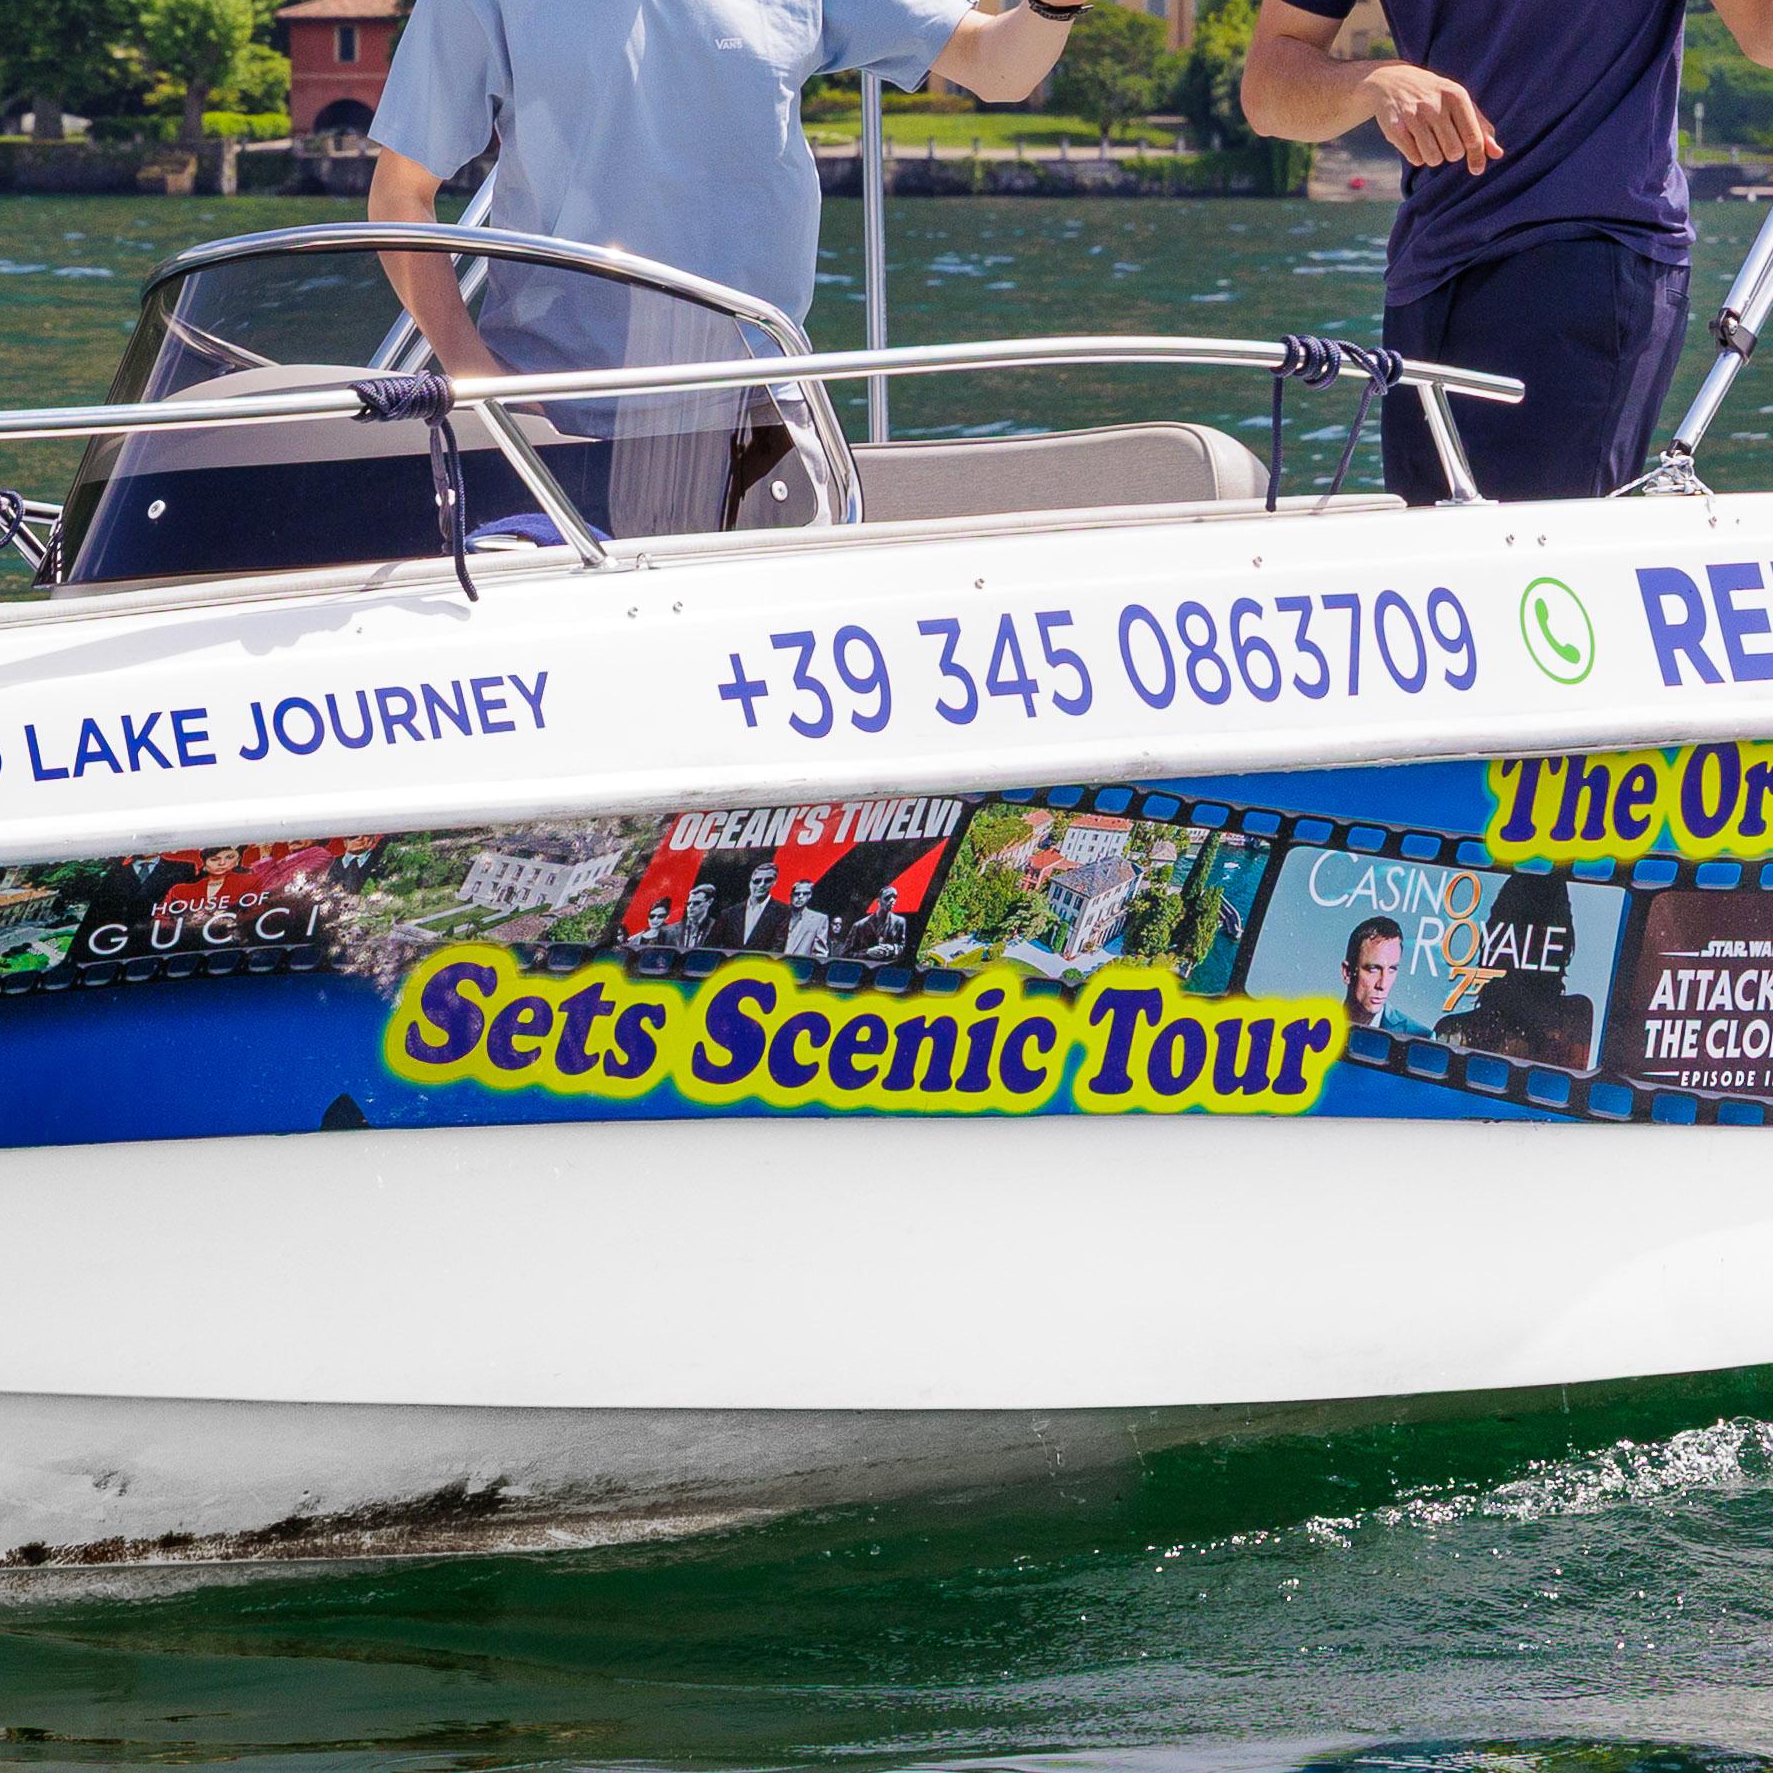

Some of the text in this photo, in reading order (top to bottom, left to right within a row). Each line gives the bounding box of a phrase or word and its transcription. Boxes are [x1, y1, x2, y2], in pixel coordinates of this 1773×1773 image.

[714, 38, 743, 50] VANS
[717, 586, 1479, 739] +39 345 0863709
[24, 707, 217, 782] LAKE
[238, 671, 549, 761] JOURNEY
[1500, 754, 1659, 843] The
[668, 804, 832, 850] OCEAN'S
[150, 891, 270, 917] HOUSE OF
[88, 904, 321, 955] GUCCI
[1700, 940, 1748, 958] STAR
[404, 961, 1332, 1097] Sets Scenic Tour
[1644, 1019, 1702, 1059] THE
[1681, 1070, 1757, 1087] EPISODE
